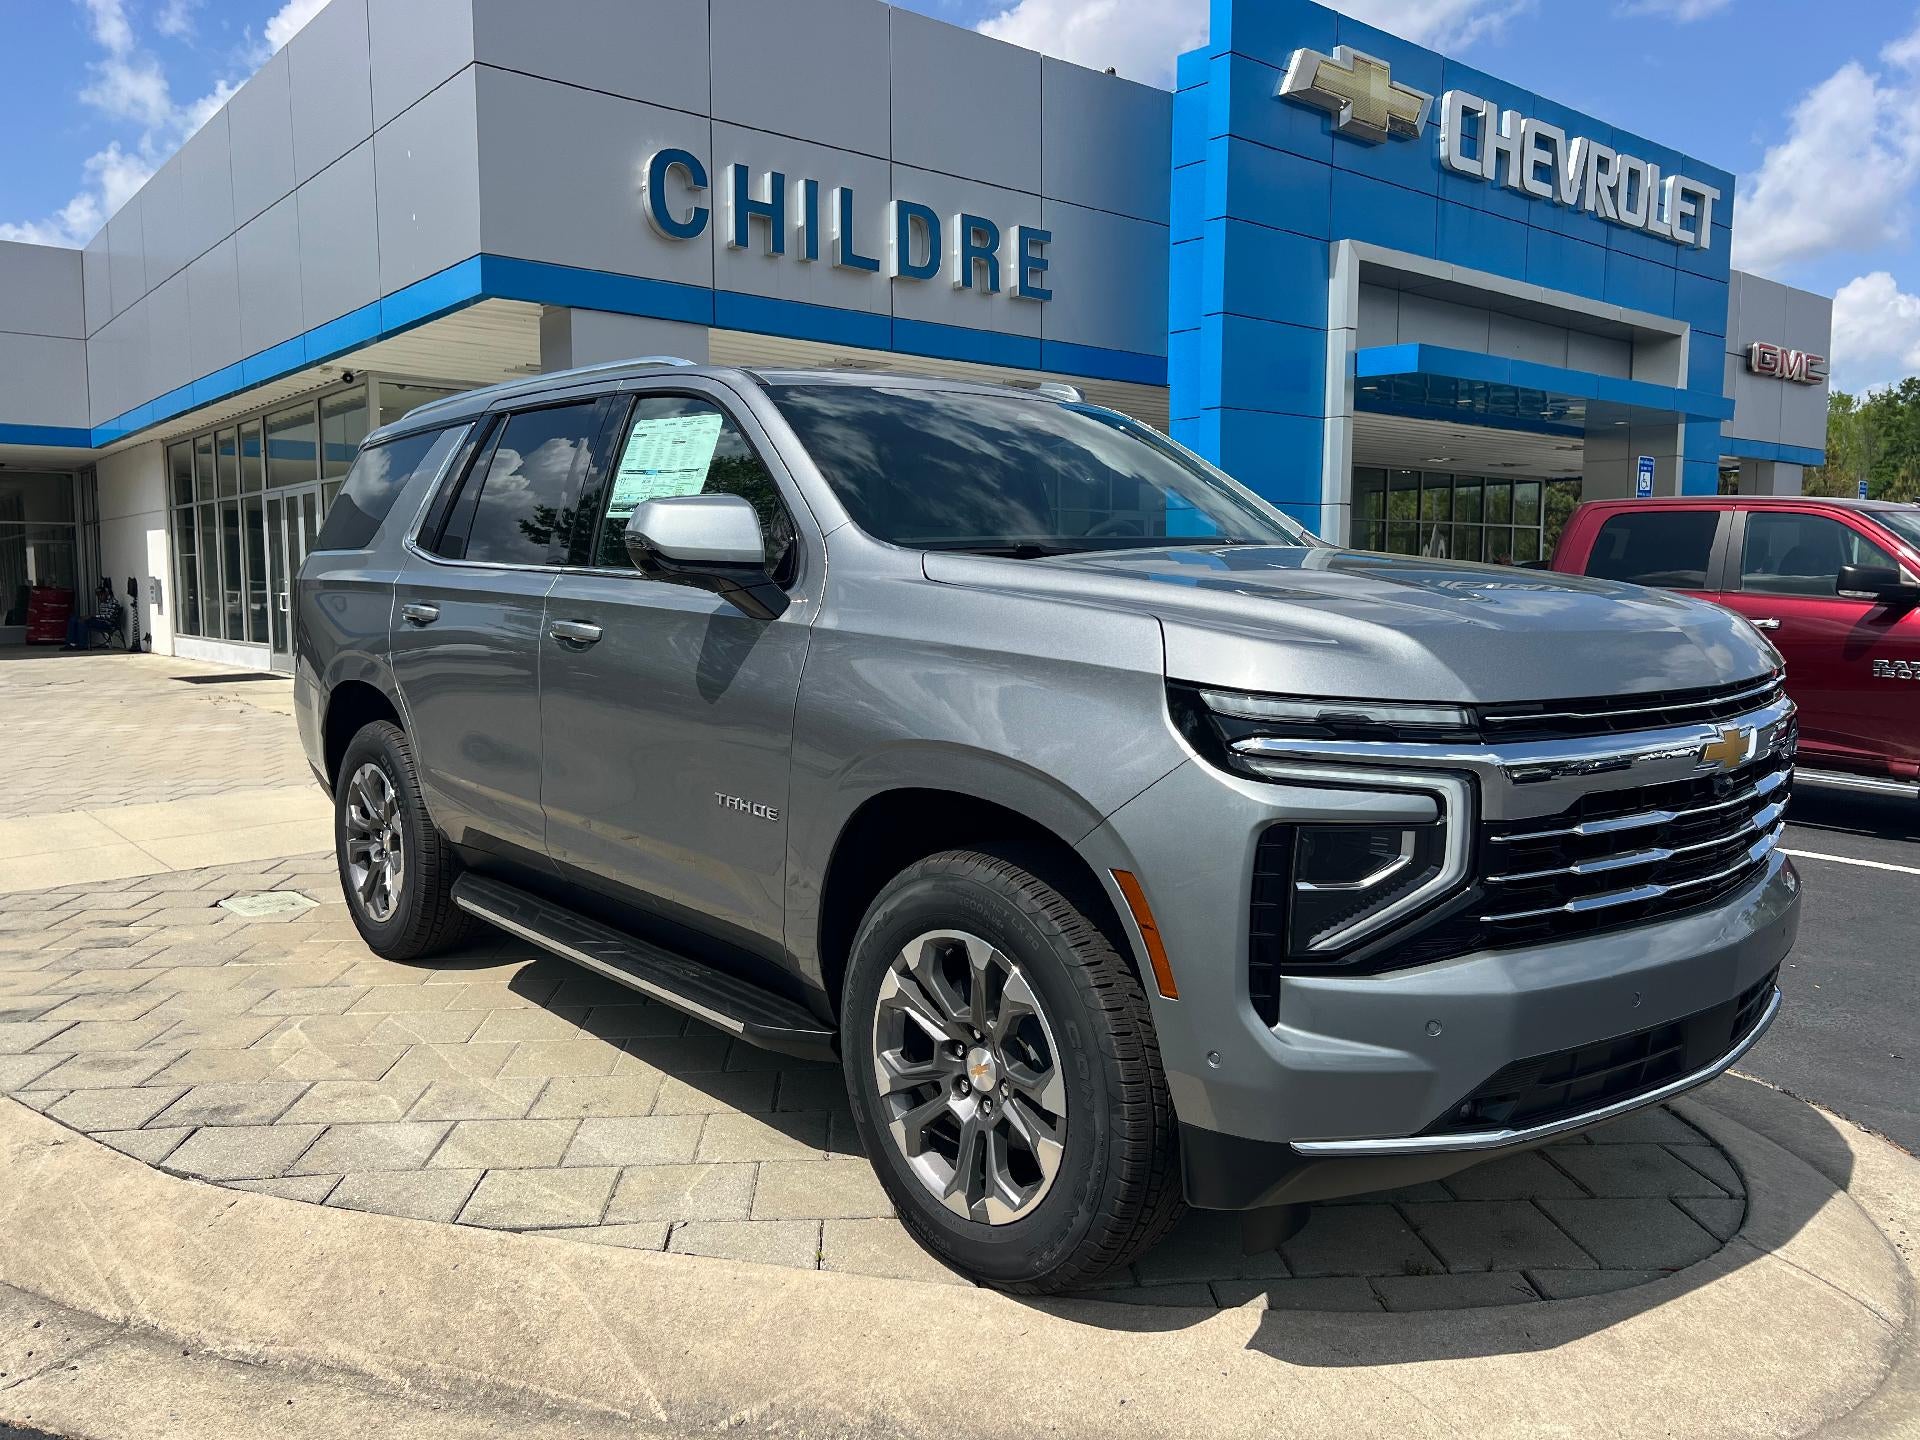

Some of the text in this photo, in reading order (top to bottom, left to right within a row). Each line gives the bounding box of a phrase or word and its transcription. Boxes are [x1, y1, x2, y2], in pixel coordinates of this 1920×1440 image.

[1440, 89, 1721, 250] CHEVROLET
[642, 147, 1053, 301] CHILDRE
[1752, 341, 1825, 385] GMC
[714, 791, 779, 821] TAHOE
